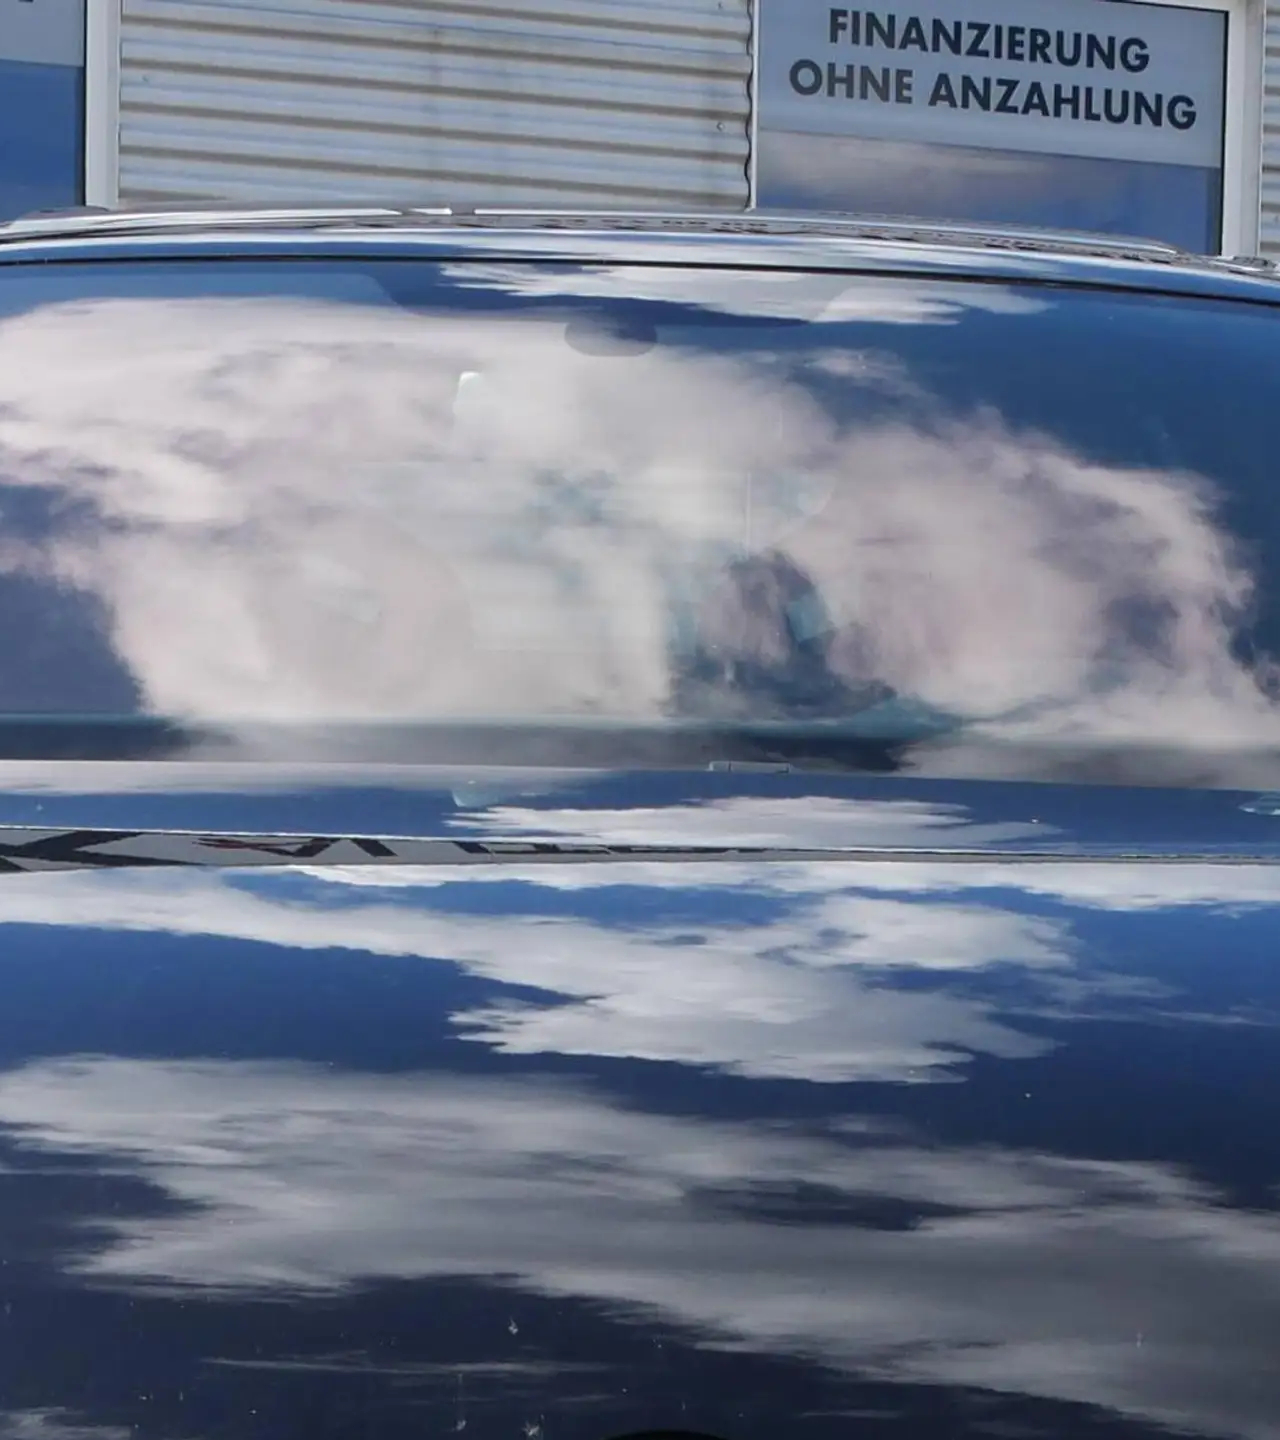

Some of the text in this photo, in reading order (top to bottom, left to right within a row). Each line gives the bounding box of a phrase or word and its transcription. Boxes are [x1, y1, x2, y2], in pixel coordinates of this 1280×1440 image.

[829, 7, 1151, 74] FINANZIERUNG
[788, 59, 1198, 130] OHNE ANZAHLUNG
